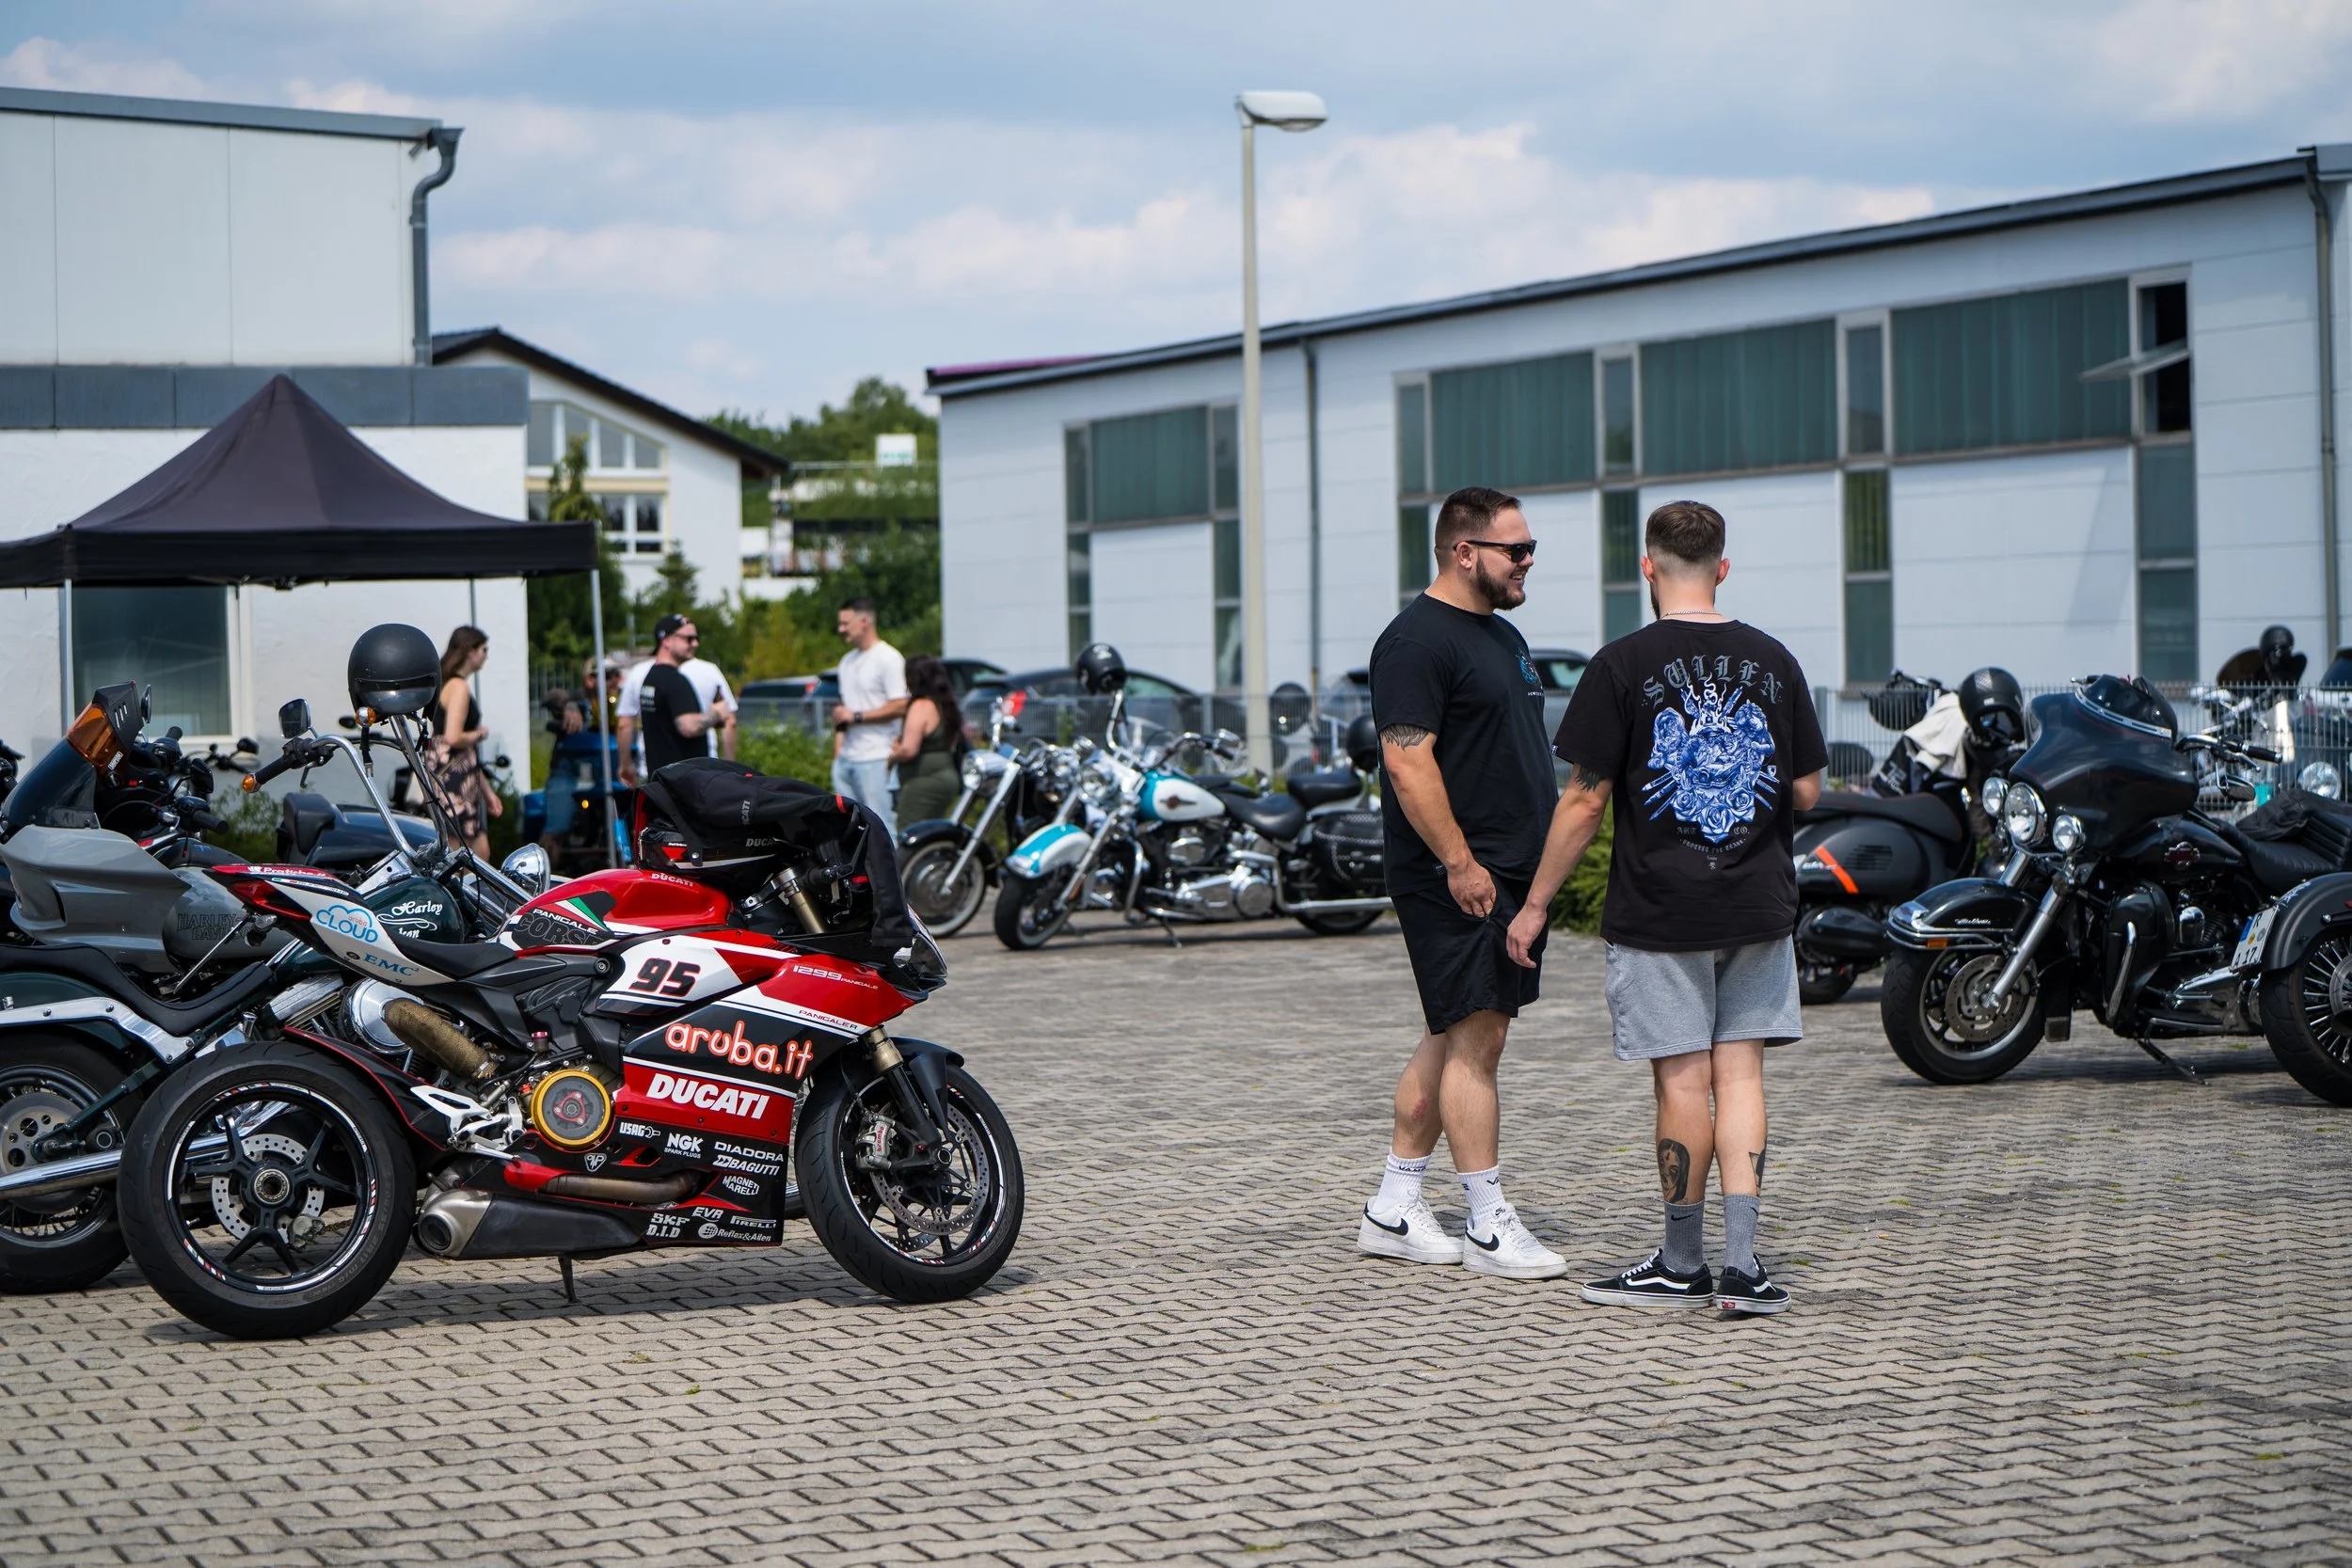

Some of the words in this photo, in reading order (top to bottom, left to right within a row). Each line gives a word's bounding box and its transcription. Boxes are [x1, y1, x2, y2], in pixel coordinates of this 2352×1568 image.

[1644, 655, 1783, 709] SULLEN
[741, 800, 751, 825] CATI
[651, 872, 694, 887] DUCATI
[391, 900, 443, 916] Harley
[316, 909, 378, 943] CLOUD
[348, 914, 368, 927] aruba
[532, 909, 599, 936] PANIGALE
[628, 958, 701, 998] 95
[793, 964, 843, 981] 1299
[840, 977, 879, 990] PANIGALE
[799, 1009, 850, 1027] PANIGALE
[665, 1021, 814, 1080] aruba.it
[646, 1072, 771, 1120] DUCATI
[619, 1121, 646, 1137] USAG
[666, 1132, 704, 1153] NGK
[876, 1126, 884, 1152] brembo
[663, 1147, 682, 1156] SPARK
[682, 1150, 701, 1159] PLUGS
[714, 1141, 784, 1163] DIADORA
[728, 1158, 780, 1176] BAGUTTI
[651, 1212, 691, 1227] SKF
[691, 1206, 723, 1220] EVR
[646, 1224, 681, 1239] D.I.D
[717, 1227, 771, 1243] Reflex&Allen
